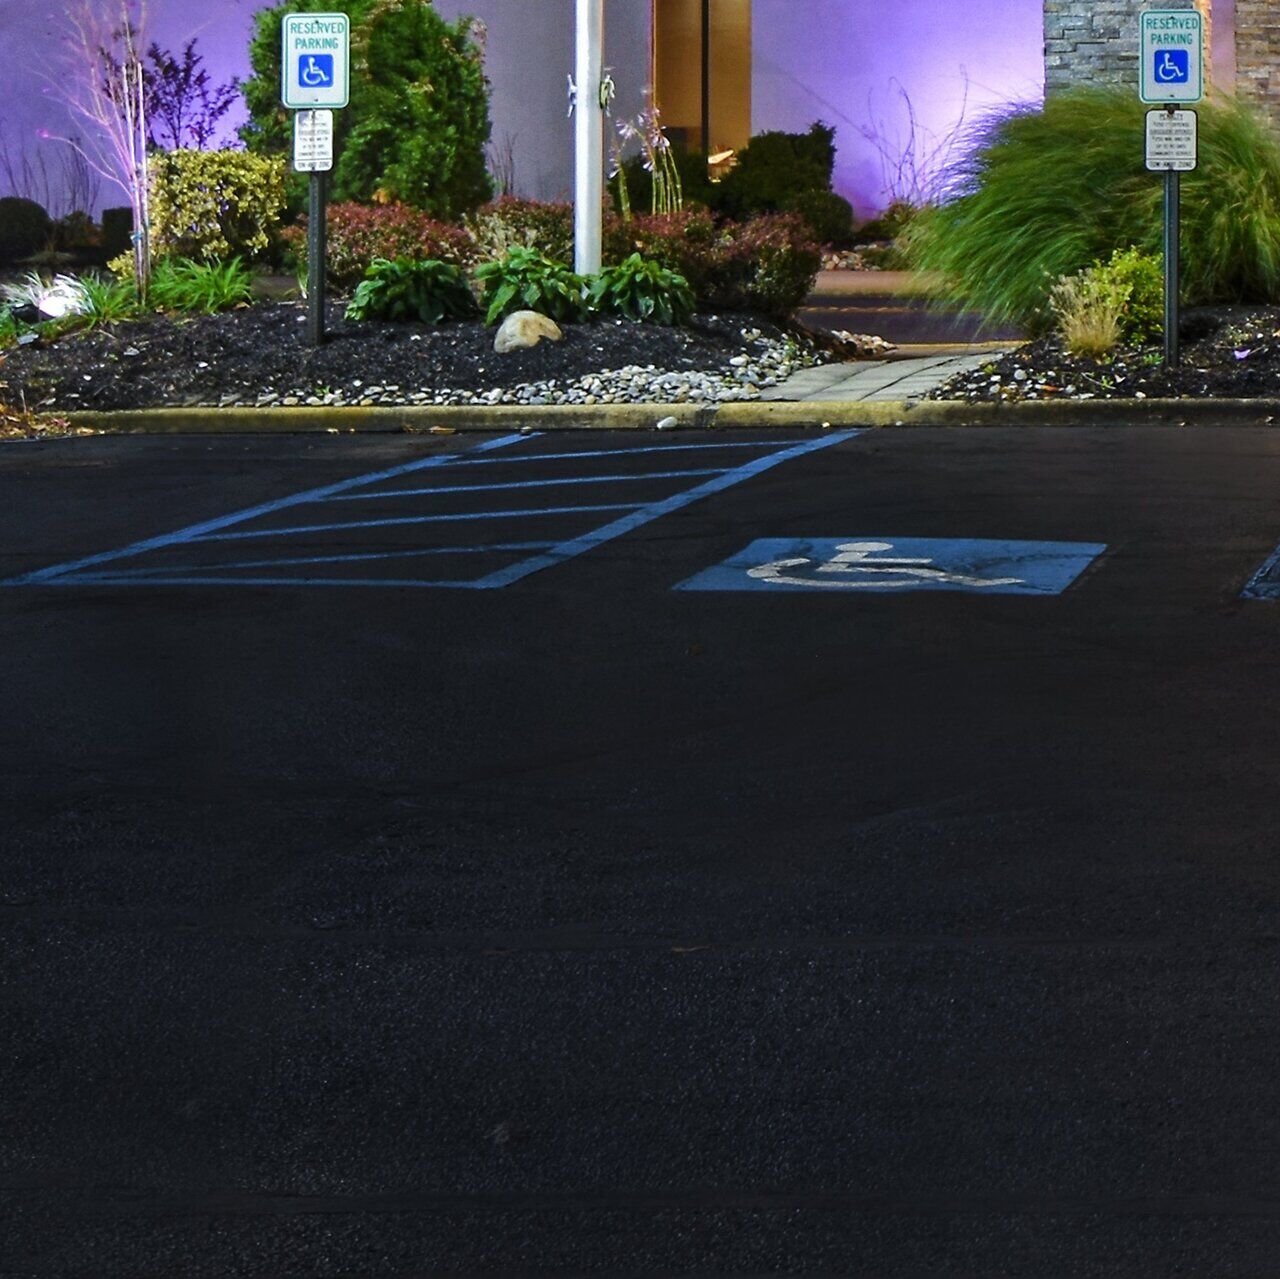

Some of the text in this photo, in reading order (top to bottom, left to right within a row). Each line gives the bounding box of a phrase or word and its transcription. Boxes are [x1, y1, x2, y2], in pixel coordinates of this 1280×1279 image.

[290, 22, 345, 34] RESERVED
[1146, 18, 1199, 30] RESERVED
[295, 37, 339, 50] PARKING
[1150, 33, 1193, 45] PARKING
